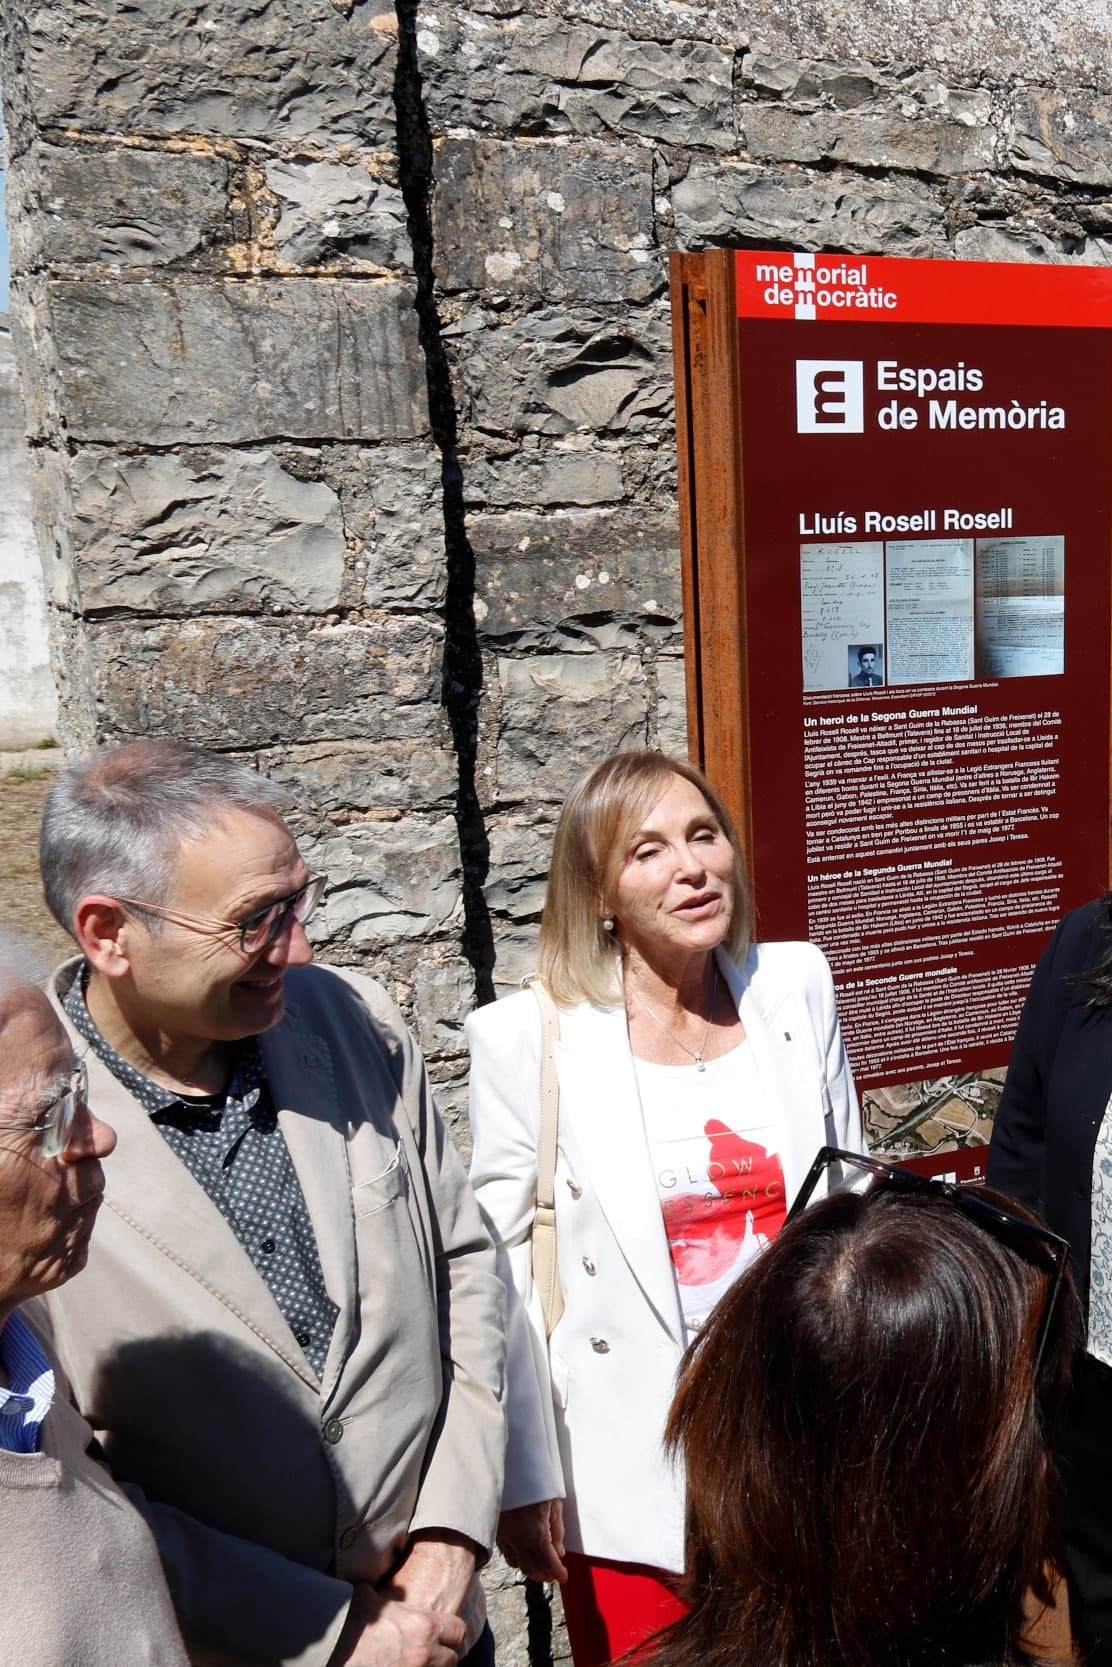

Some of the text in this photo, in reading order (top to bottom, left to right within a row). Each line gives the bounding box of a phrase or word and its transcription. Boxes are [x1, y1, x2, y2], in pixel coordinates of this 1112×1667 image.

[756, 263, 867, 286] memorial
[764, 282, 897, 309] democràtic
[877, 360, 983, 398] Espais
[878, 399, 1066, 430] de Memòria
[799, 507, 1013, 535] Lluís Rosell Rosell
[804, 706, 977, 727] Un heroi de la Segona Guerra Mundial
[808, 875, 818, 883] Un
[820, 872, 842, 881] héroe
[863, 866, 896, 878] Segunda
[897, 862, 922, 872] Guerra
[924, 859, 952, 869] Mundial
[846, 981, 855, 989] de
[865, 975, 897, 986] Seconde
[899, 972, 923, 981] Guerre
[925, 966, 957, 978] mondiale
[658, 1157, 752, 1189] GLOW
